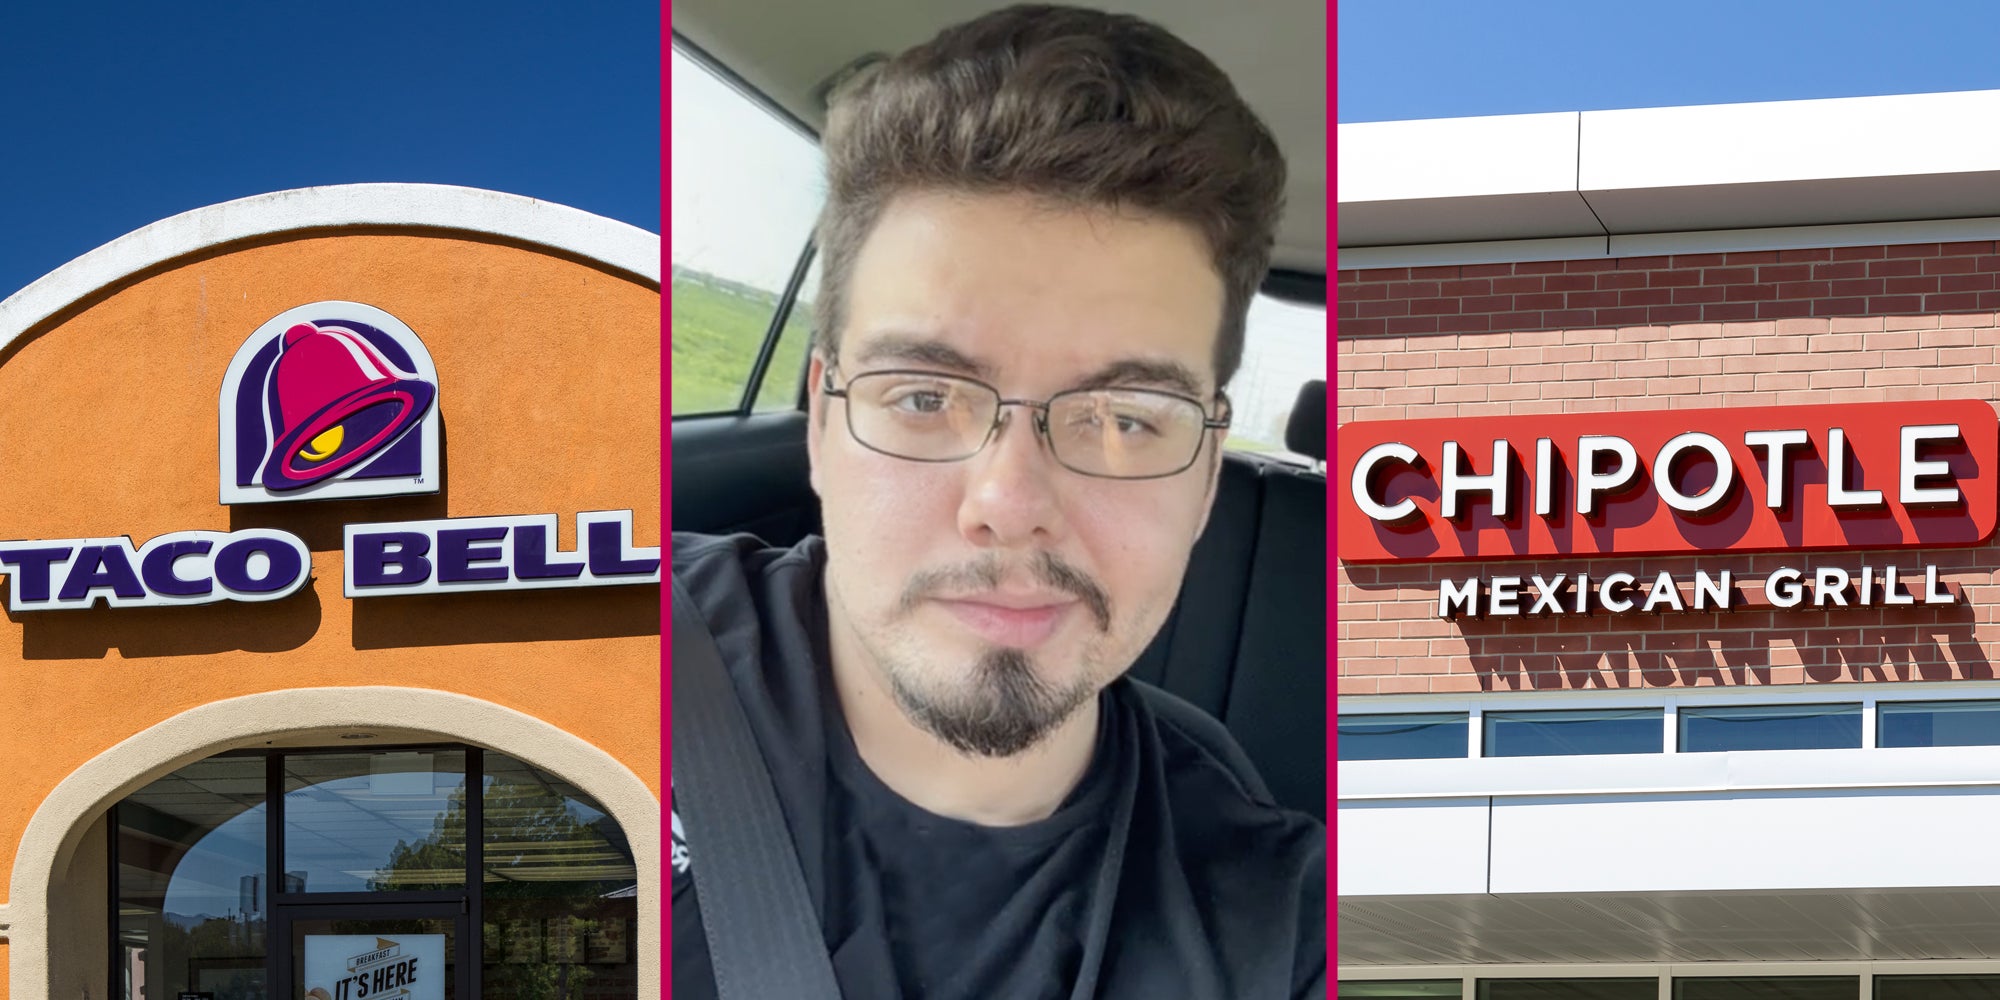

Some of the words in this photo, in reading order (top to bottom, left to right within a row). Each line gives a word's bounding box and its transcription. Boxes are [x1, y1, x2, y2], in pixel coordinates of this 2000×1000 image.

[1351, 424, 1960, 522] CHIPOTLE
[0, 536, 301, 602] TACO
[353, 521, 660, 587] BELL
[1438, 569, 1732, 620] MEXICAN
[1764, 564, 1955, 608] GRILL
[335, 972, 370, 1000] IT'S
[372, 957, 418, 994] HERE
[356, 949, 391, 966] BREAKFAST
